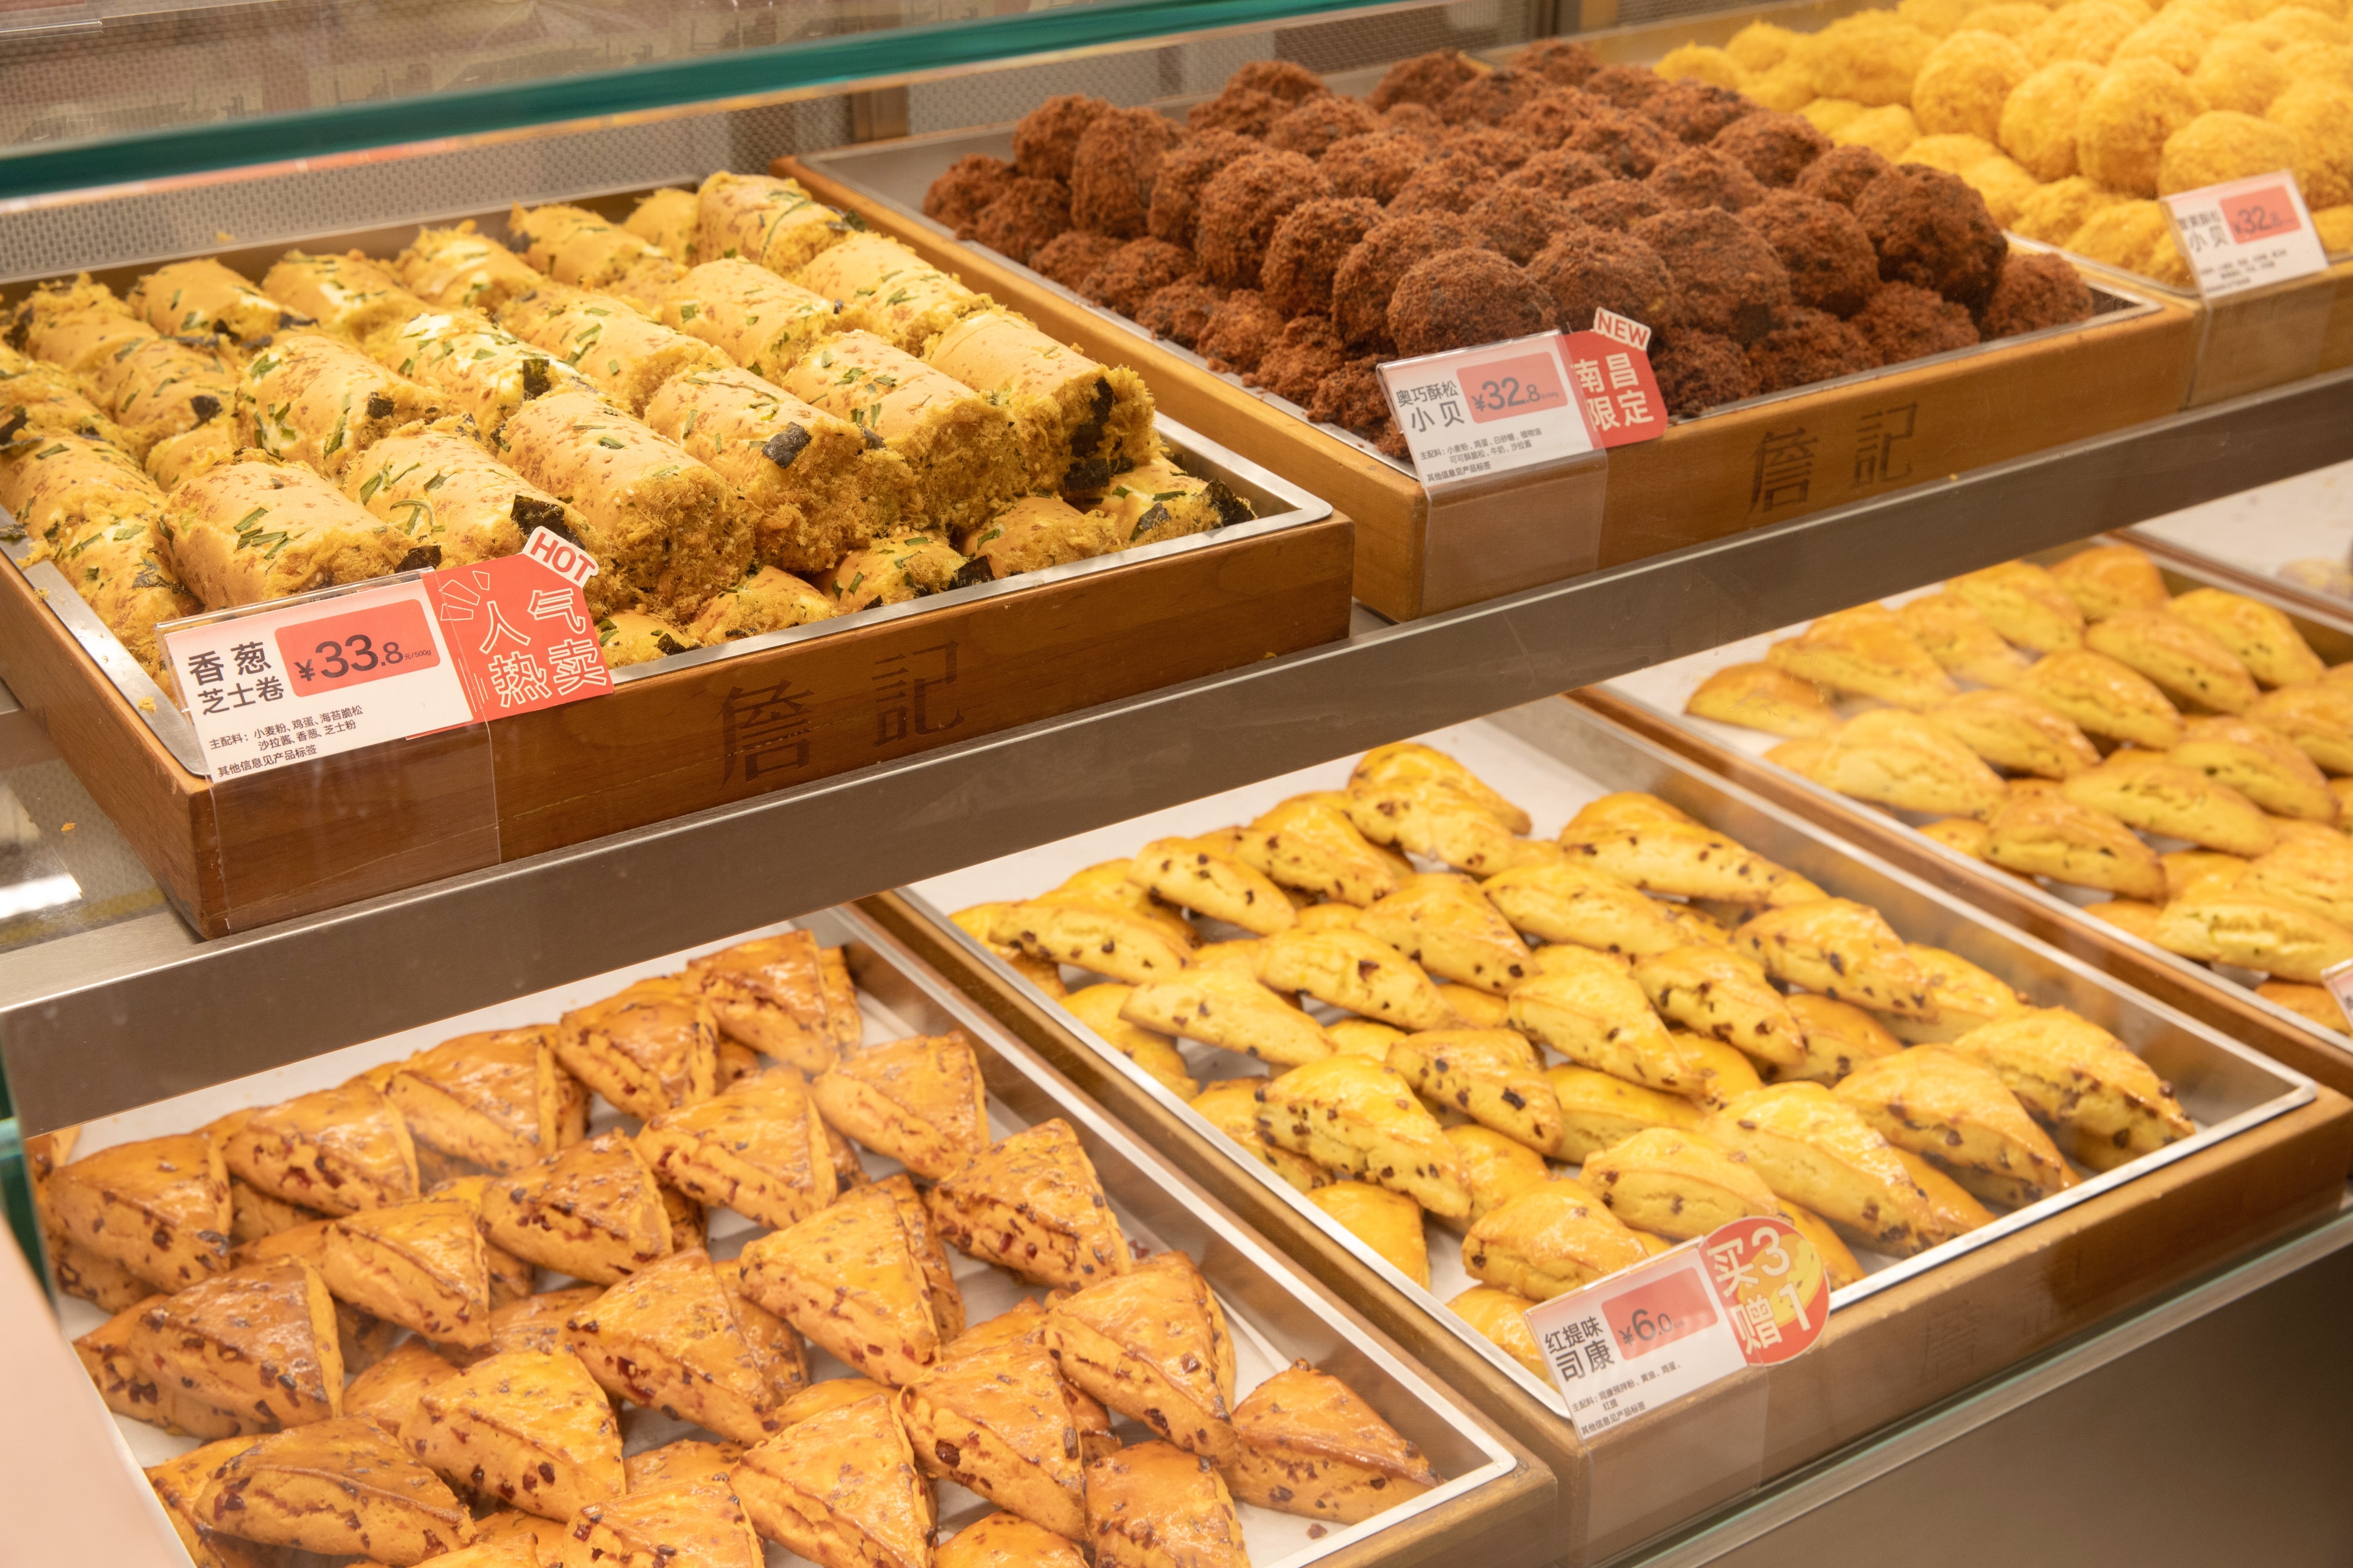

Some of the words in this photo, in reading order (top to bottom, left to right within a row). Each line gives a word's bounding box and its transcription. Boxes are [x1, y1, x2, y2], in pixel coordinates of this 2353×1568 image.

[1598, 313, 1649, 348] NEW
[1395, 380, 1459, 408] 奥巧酥松
[1571, 352, 1640, 395] 南昌
[1411, 399, 1466, 433] 小贝
[1586, 389, 1654, 433] 限定
[528, 531, 596, 583] HOT
[480, 587, 586, 654] 人气
[188, 641, 272, 686] 香葱
[488, 638, 607, 708] 热卖
[198, 675, 284, 716] 芝士卷
[712, 640, 966, 793] 詹記
[217, 744, 318, 778] 其他信息见产品标签
[1706, 1226, 1791, 1297] 买3
[1545, 1316, 1603, 1354] 红提味
[1730, 1283, 1812, 1355] 赠1
[1555, 1338, 1615, 1383] 司康
